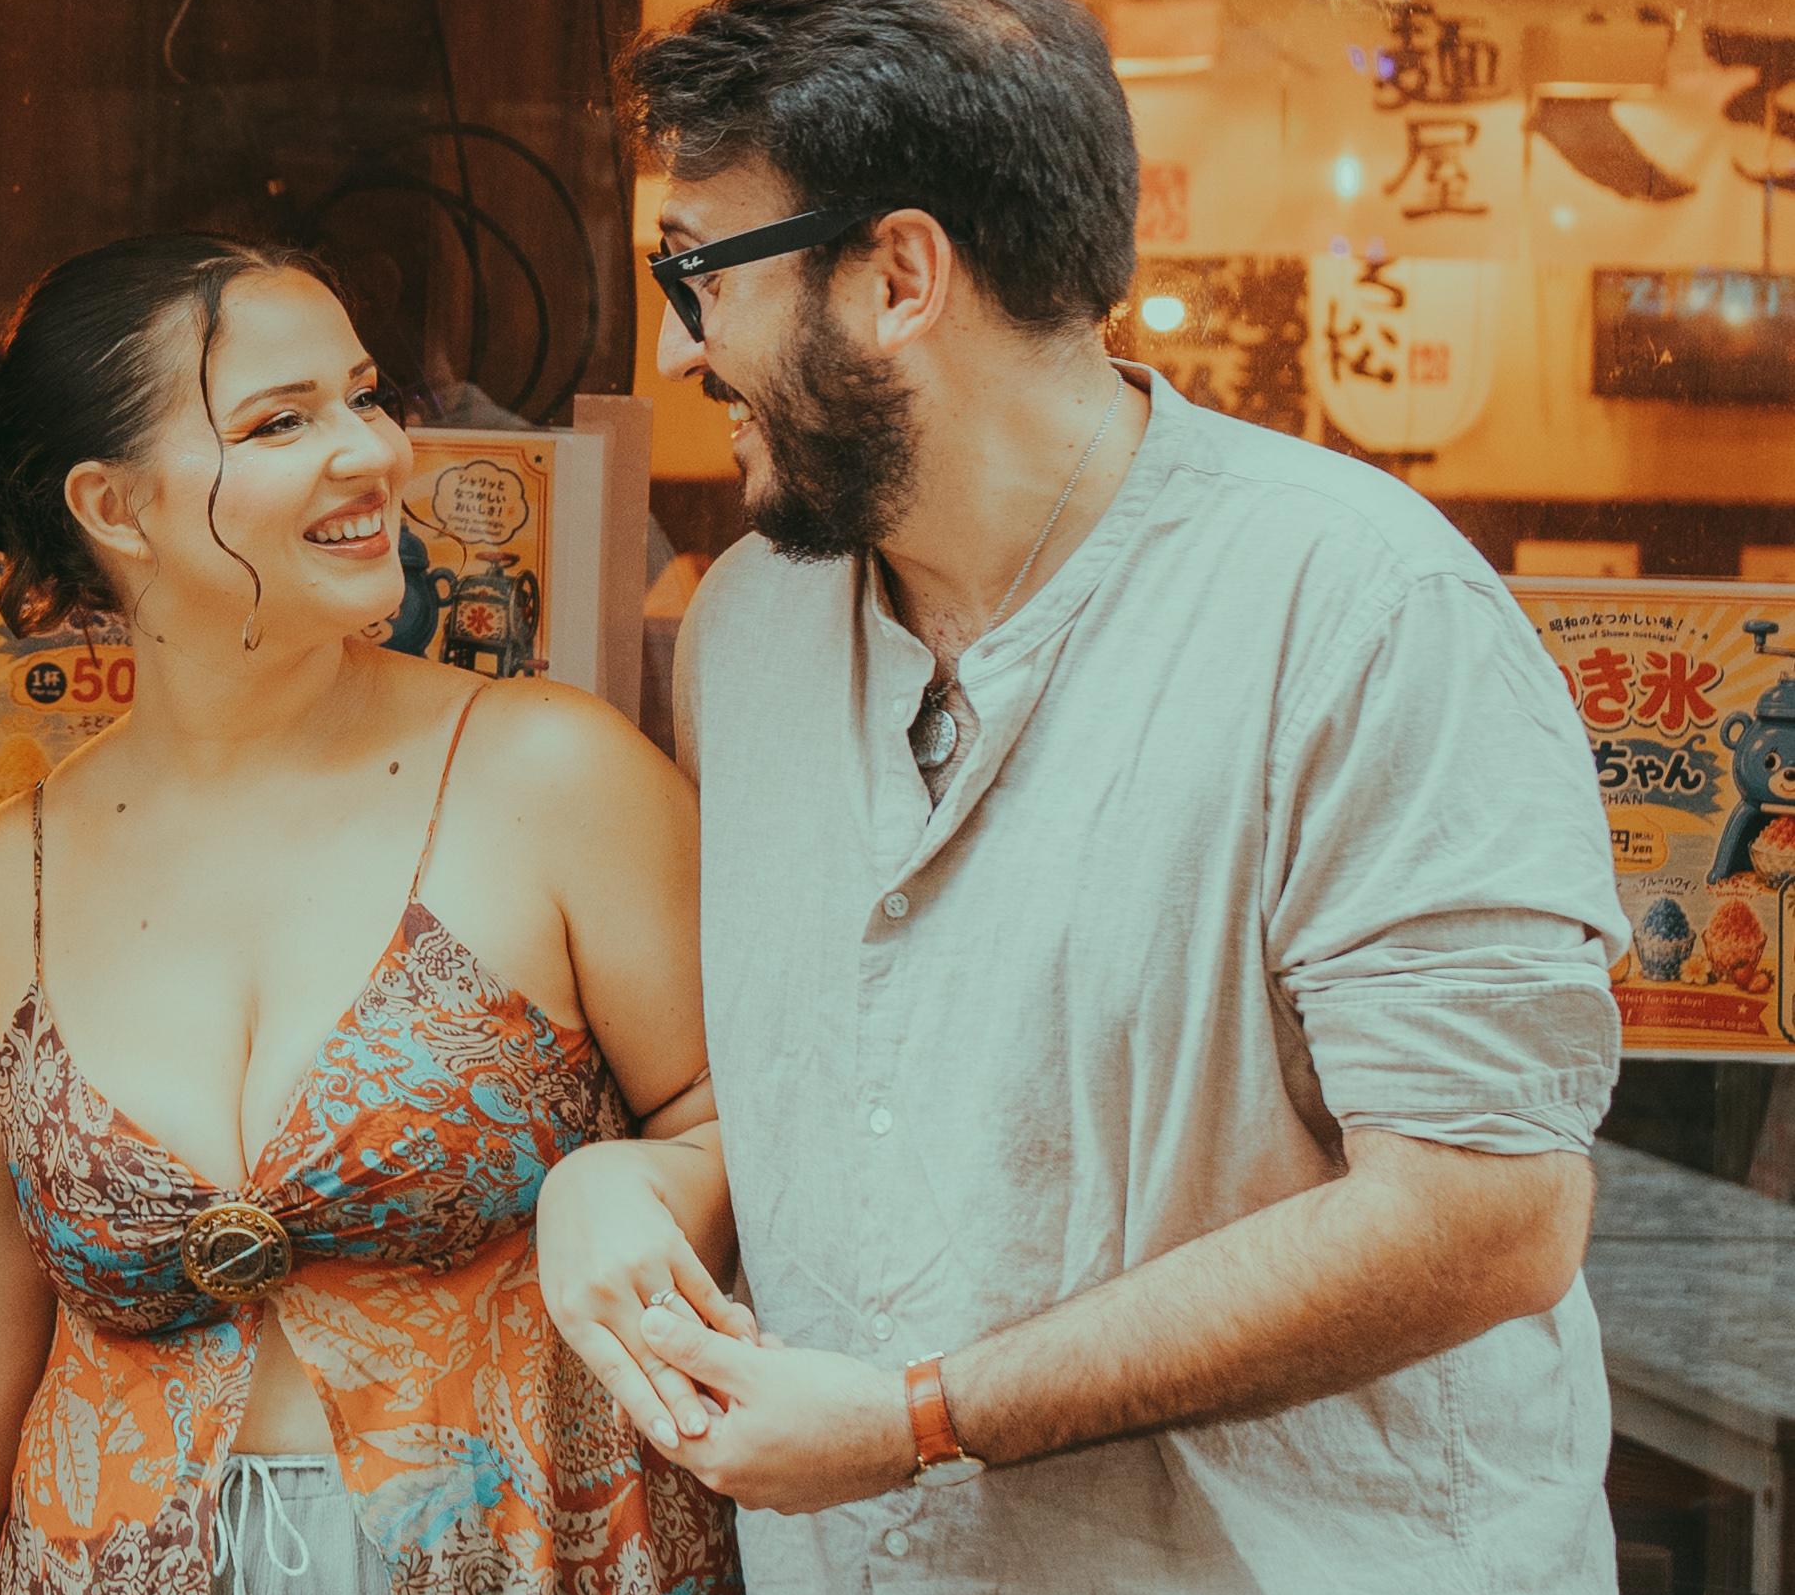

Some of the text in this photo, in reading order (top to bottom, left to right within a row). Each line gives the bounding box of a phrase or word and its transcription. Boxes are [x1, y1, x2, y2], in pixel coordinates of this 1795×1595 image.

[467, 605, 494, 634] 氷
[1549, 611, 1683, 632] 昭和のなつかしい味!
[1559, 647, 1718, 730] き氷
